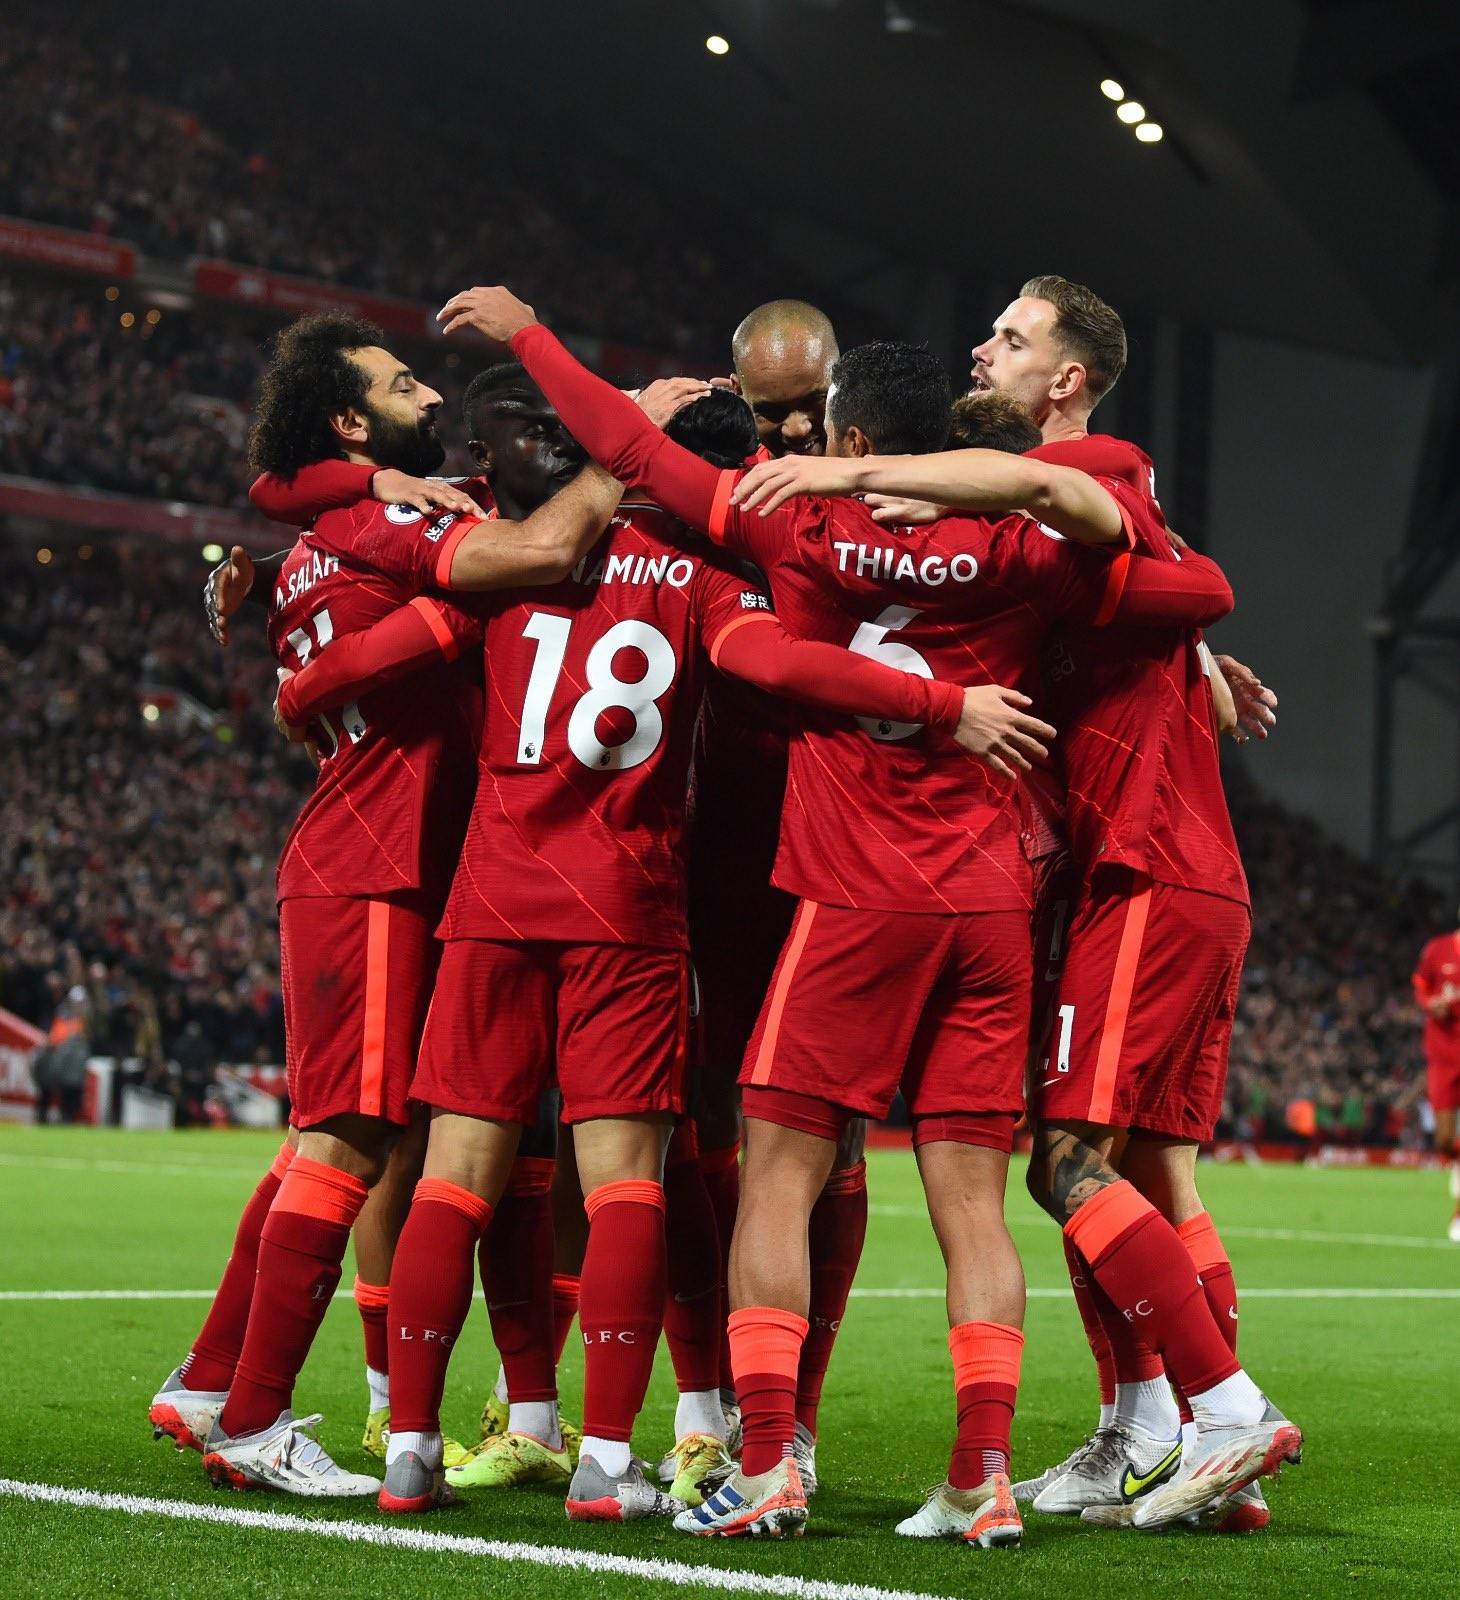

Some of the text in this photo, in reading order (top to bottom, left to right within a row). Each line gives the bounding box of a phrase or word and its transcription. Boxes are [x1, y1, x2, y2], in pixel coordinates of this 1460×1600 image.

[740, 591, 757, 601] No
[833, 541, 979, 587] THIAGO
[516, 612, 677, 770] 18
[848, 604, 936, 740] 6
